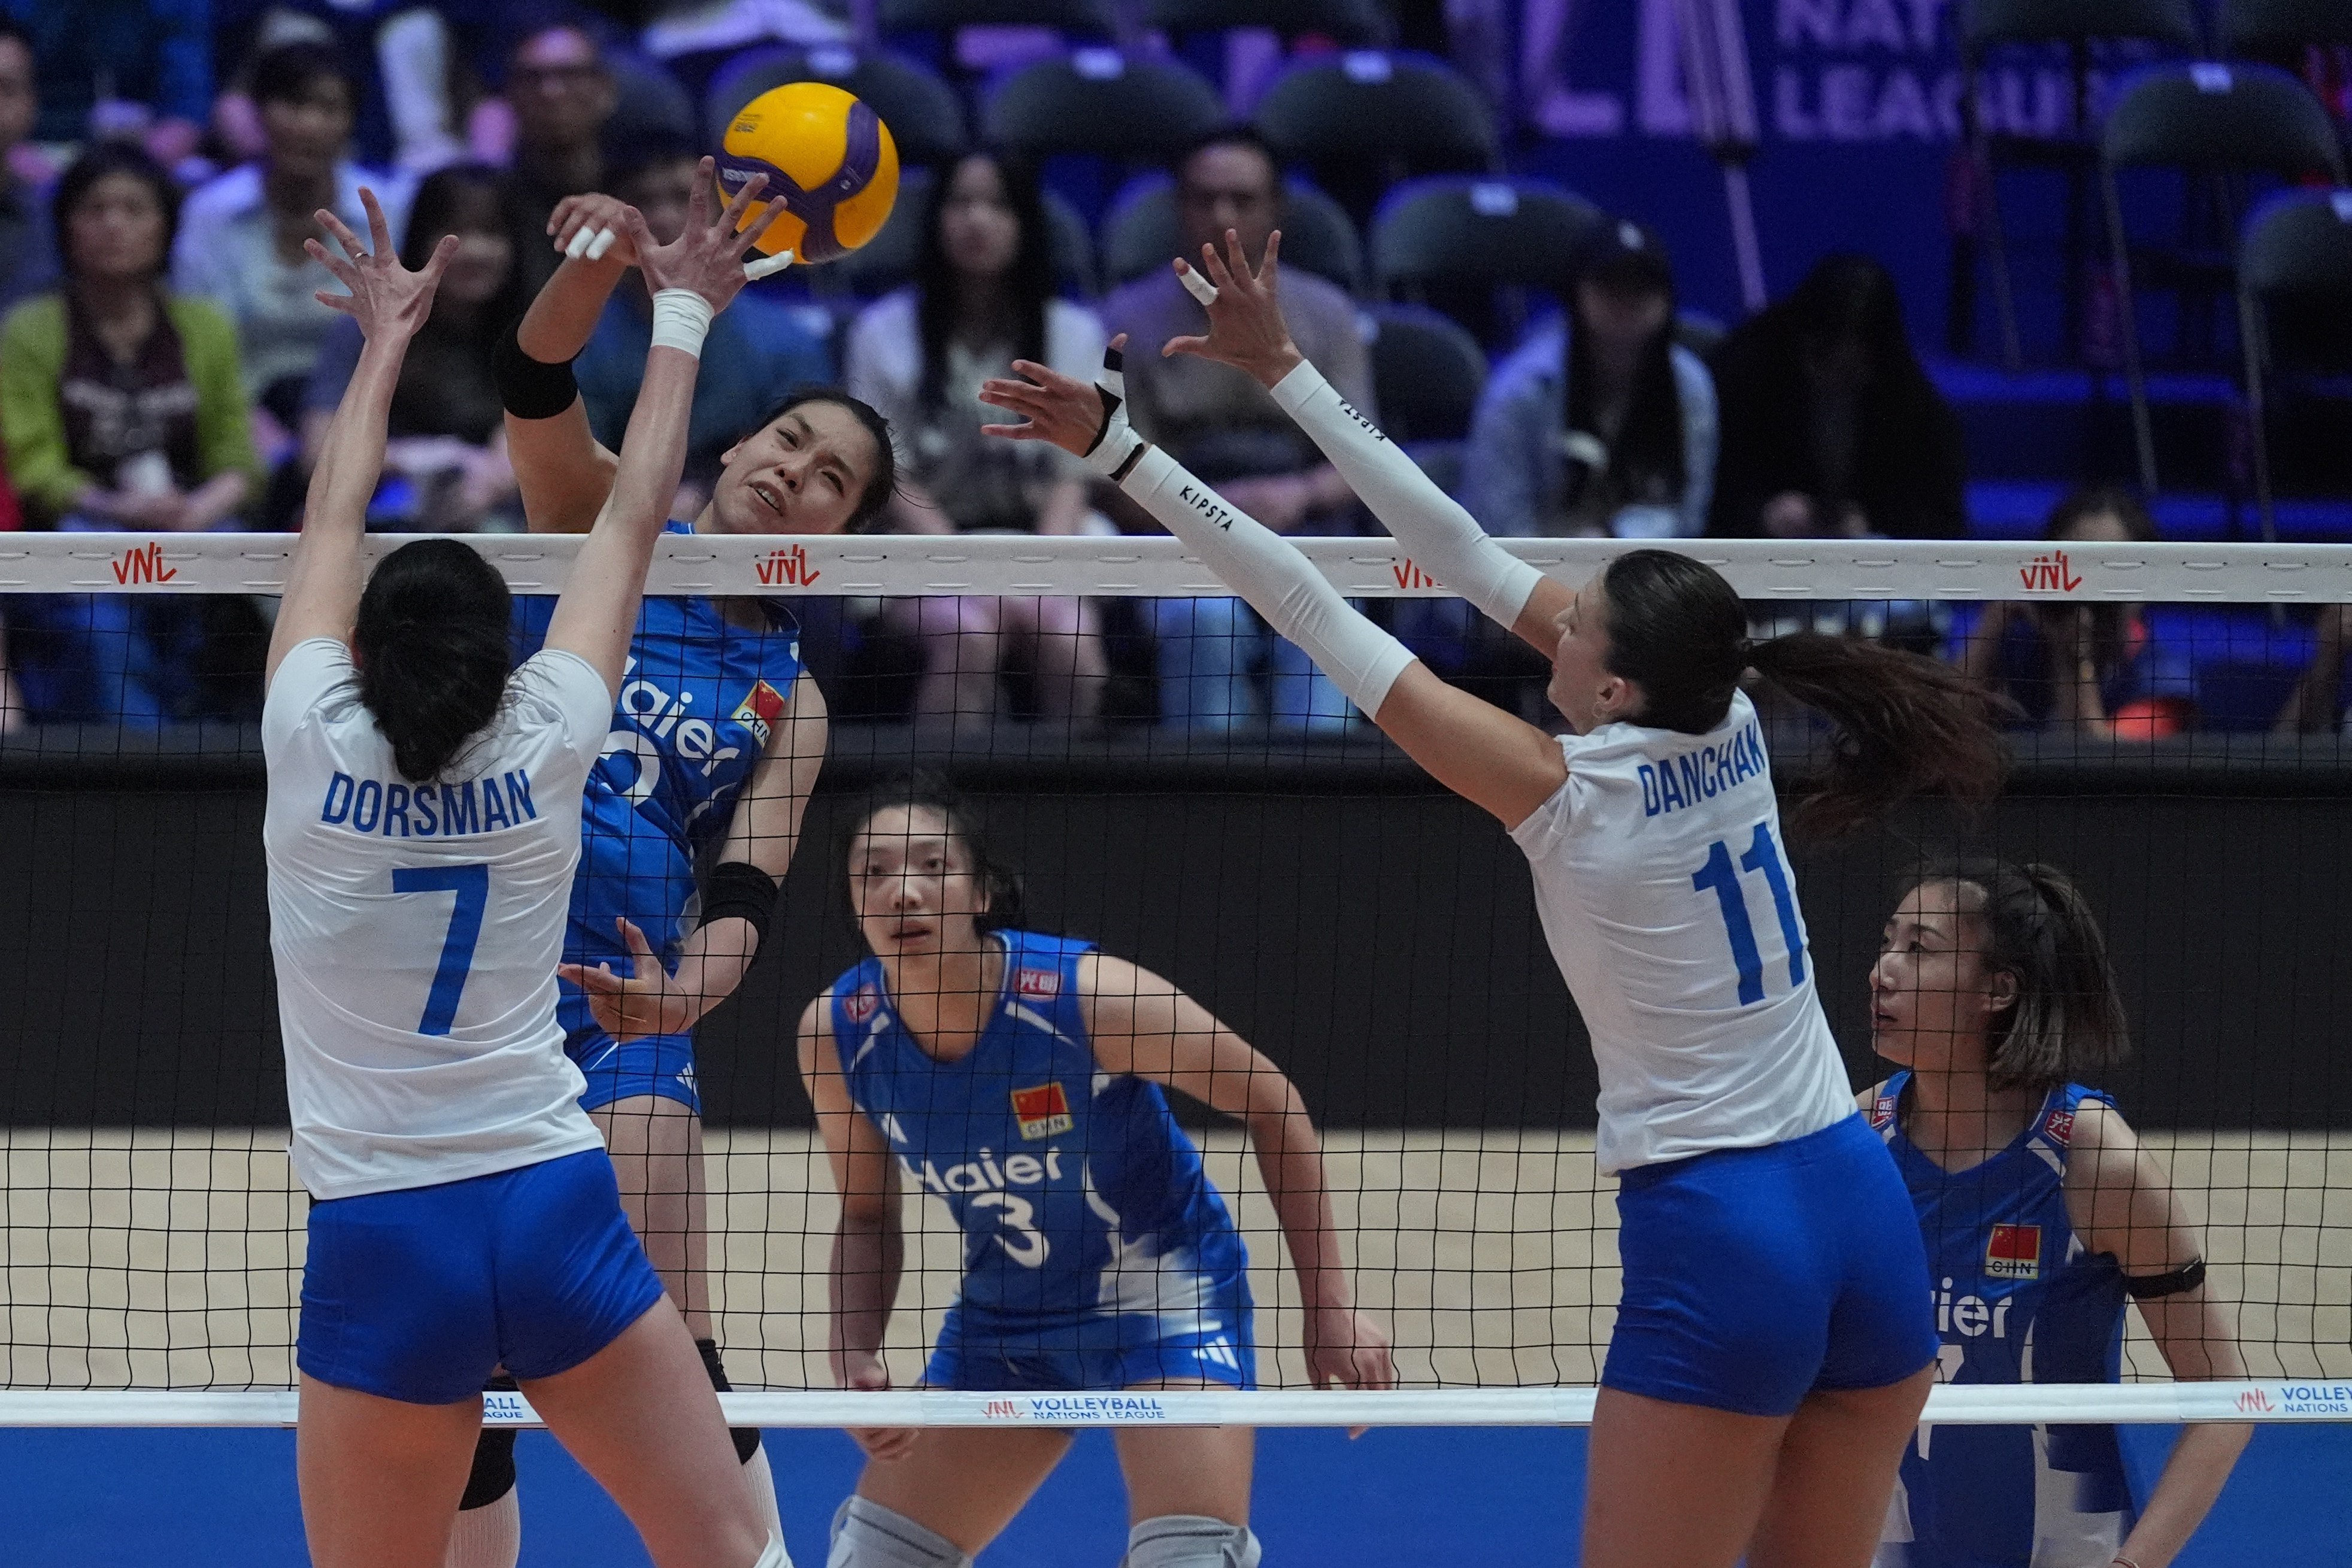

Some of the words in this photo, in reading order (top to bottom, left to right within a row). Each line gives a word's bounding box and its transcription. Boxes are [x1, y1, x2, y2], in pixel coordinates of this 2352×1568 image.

[1179, 485, 1233, 531] KIPSTA
[112, 542, 177, 584] VNL
[756, 544, 820, 586] VNL
[2020, 550, 2083, 592] VNL
[622, 656, 740, 778] aier
[741, 711, 769, 743] CHN
[1638, 718, 1766, 817] DANCHAK
[321, 769, 537, 837] DORSMAN
[1692, 821, 1806, 1006] 11
[392, 863, 489, 1036] 7
[1028, 1117, 1066, 1135] CHN
[899, 1146, 1062, 1196] Haier
[971, 1191, 1050, 1269] 3
[1992, 1260, 2031, 1275] CHN
[1930, 1276, 2012, 1338] ier
[484, 1397, 520, 1409] ALL
[981, 1398, 1025, 1419] VNL
[1030, 1397, 1162, 1410] VOLLEYBALL
[2233, 1388, 2275, 1413] VNL
[2284, 1403, 2348, 1413] NATIONS
